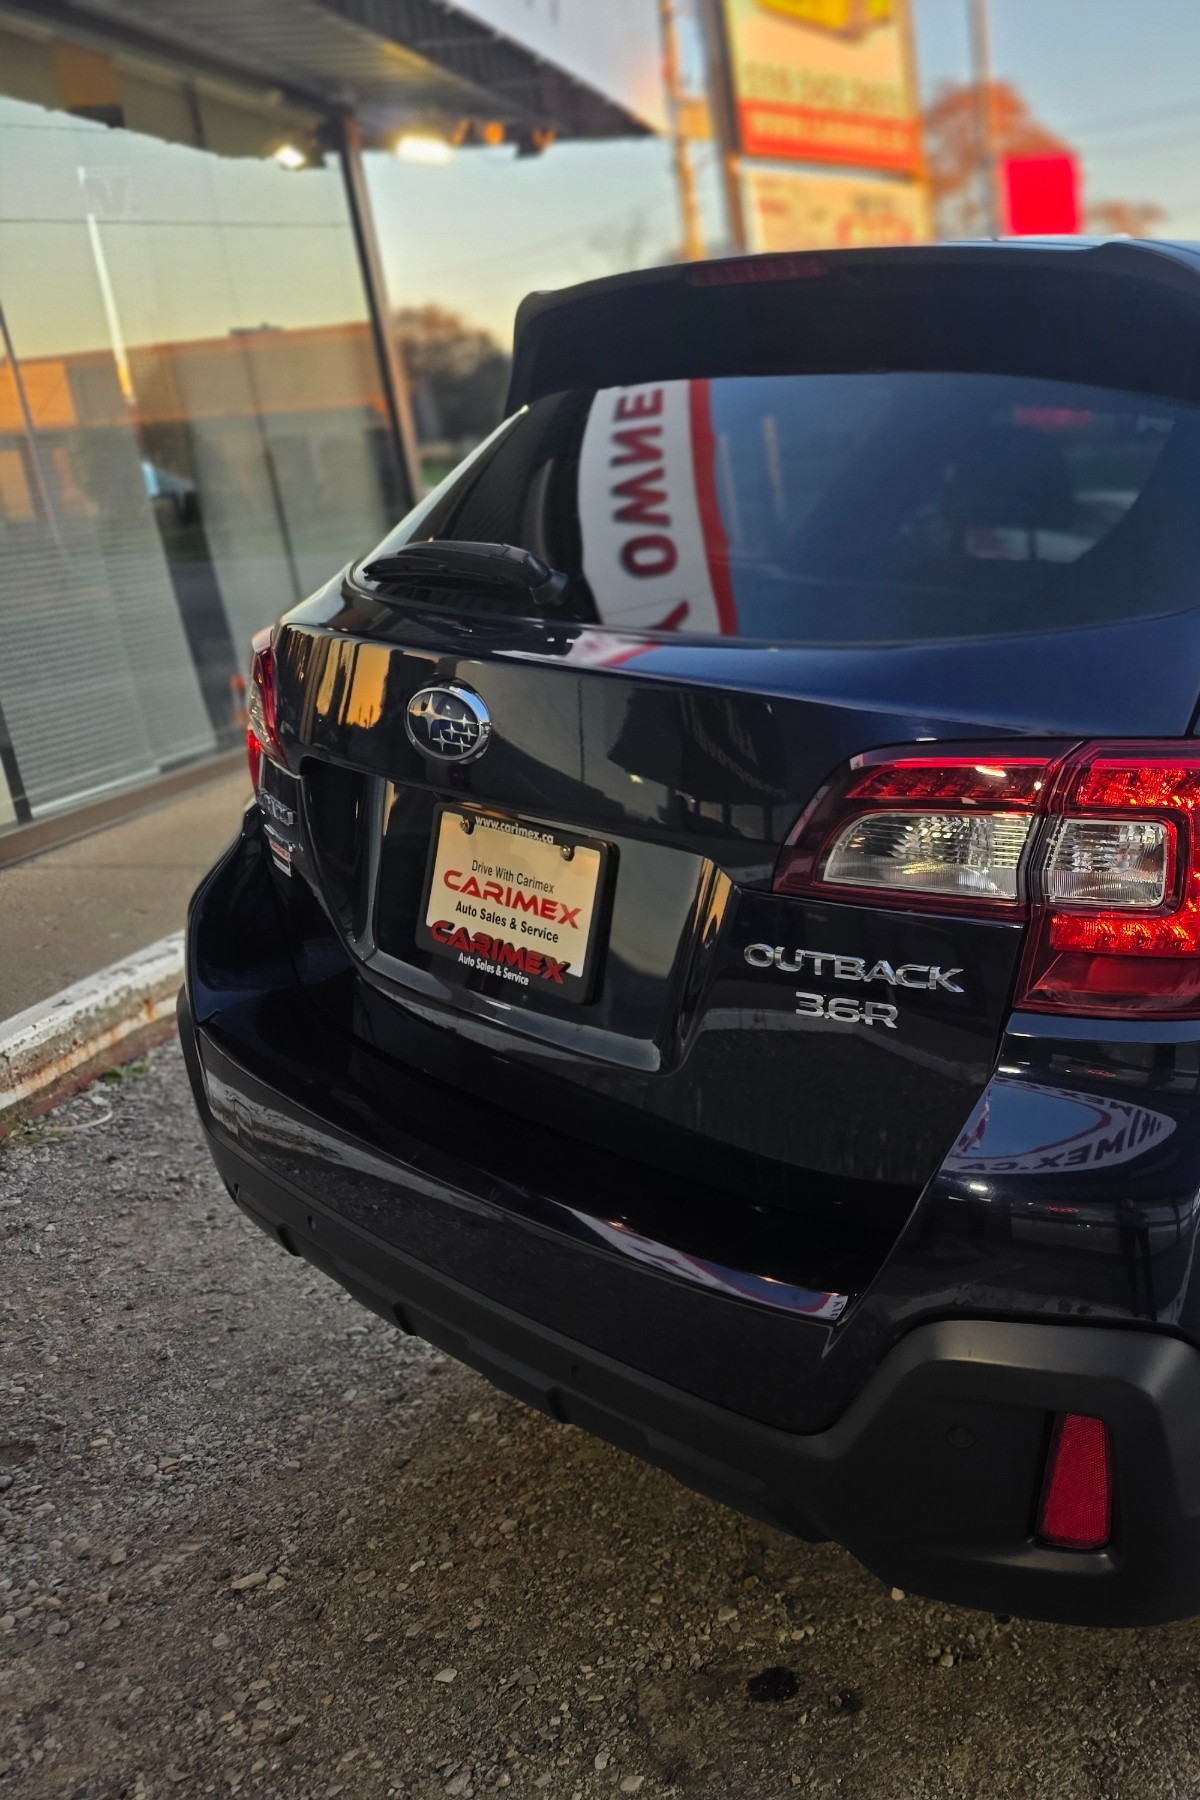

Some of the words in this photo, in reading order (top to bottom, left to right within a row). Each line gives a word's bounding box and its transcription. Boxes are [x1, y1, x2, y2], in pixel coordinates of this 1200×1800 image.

[474, 815, 555, 844] www.carimex.ca
[471, 859, 493, 876] Drive
[495, 866, 514, 883] With
[516, 872, 555, 894] Carimex
[443, 869, 582, 930] CARIMEX
[455, 900, 477, 918] Auto
[479, 908, 507, 927] Sales
[509, 917, 518, 931] &
[520, 920, 559, 944] Service
[430, 919, 571, 985] CARIMEX
[457, 952, 475, 968] Auto
[476, 958, 495, 975] Sales
[495, 965, 502, 977] &
[502, 967, 530, 987] Service
[743, 943, 965, 993] OUTBACK
